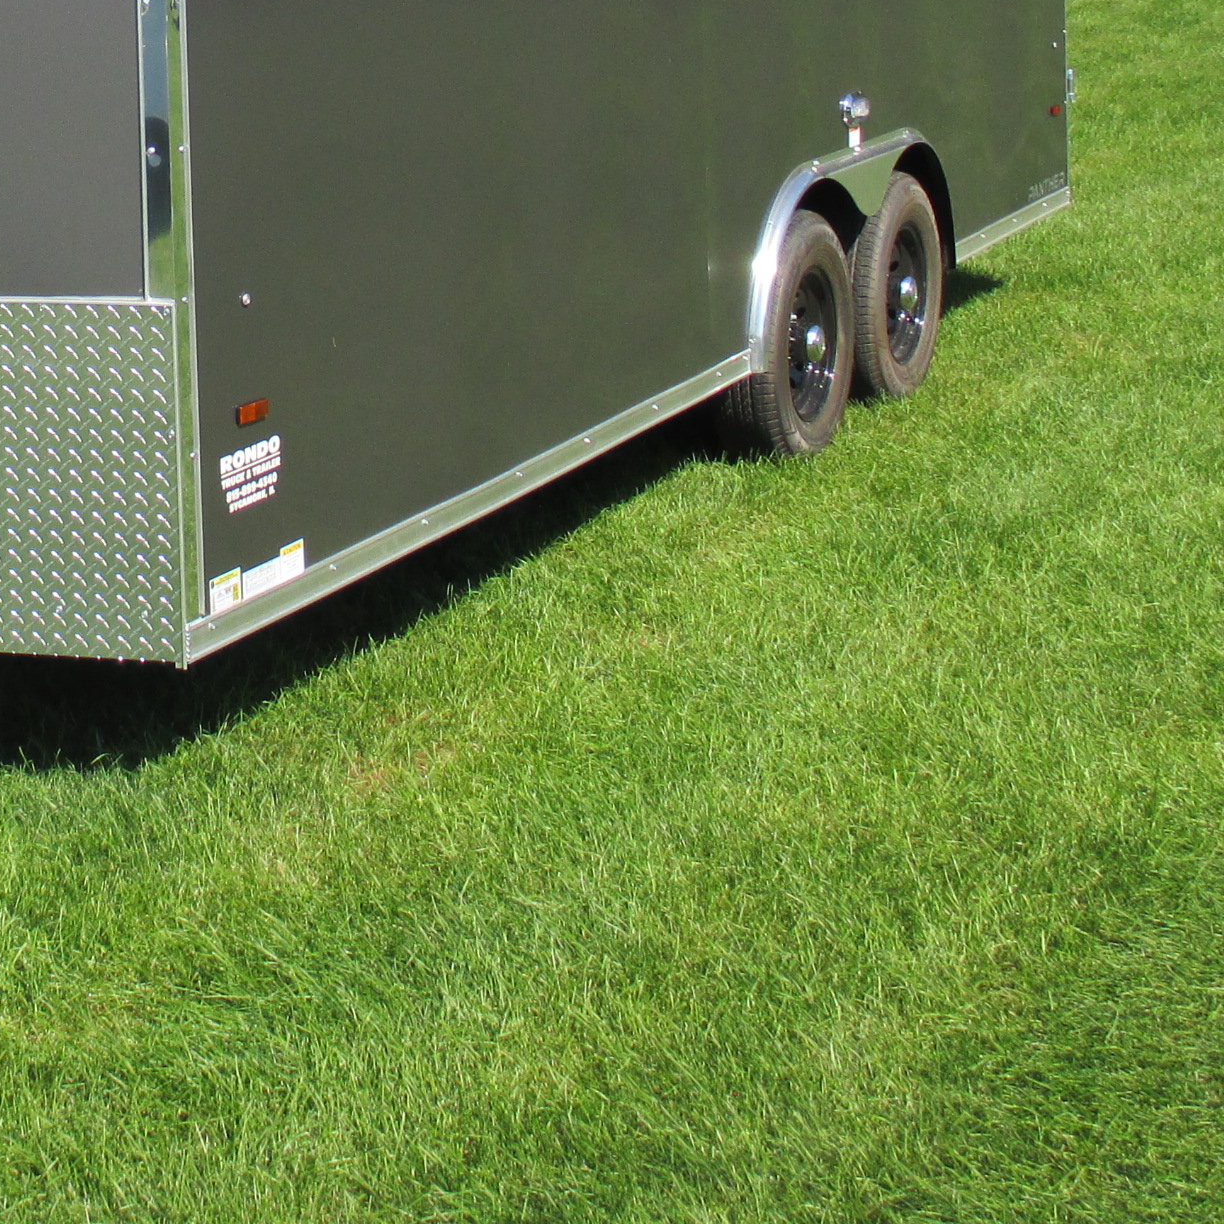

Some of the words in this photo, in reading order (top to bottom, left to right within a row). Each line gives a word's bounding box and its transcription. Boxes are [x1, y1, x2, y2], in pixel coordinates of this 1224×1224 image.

[219, 434, 281, 475] RONDO
[220, 471, 246, 491] TRUCK
[245, 468, 252, 481] &
[251, 456, 281, 477] TRAILER
[229, 488, 268, 514] SYCAMORE,
